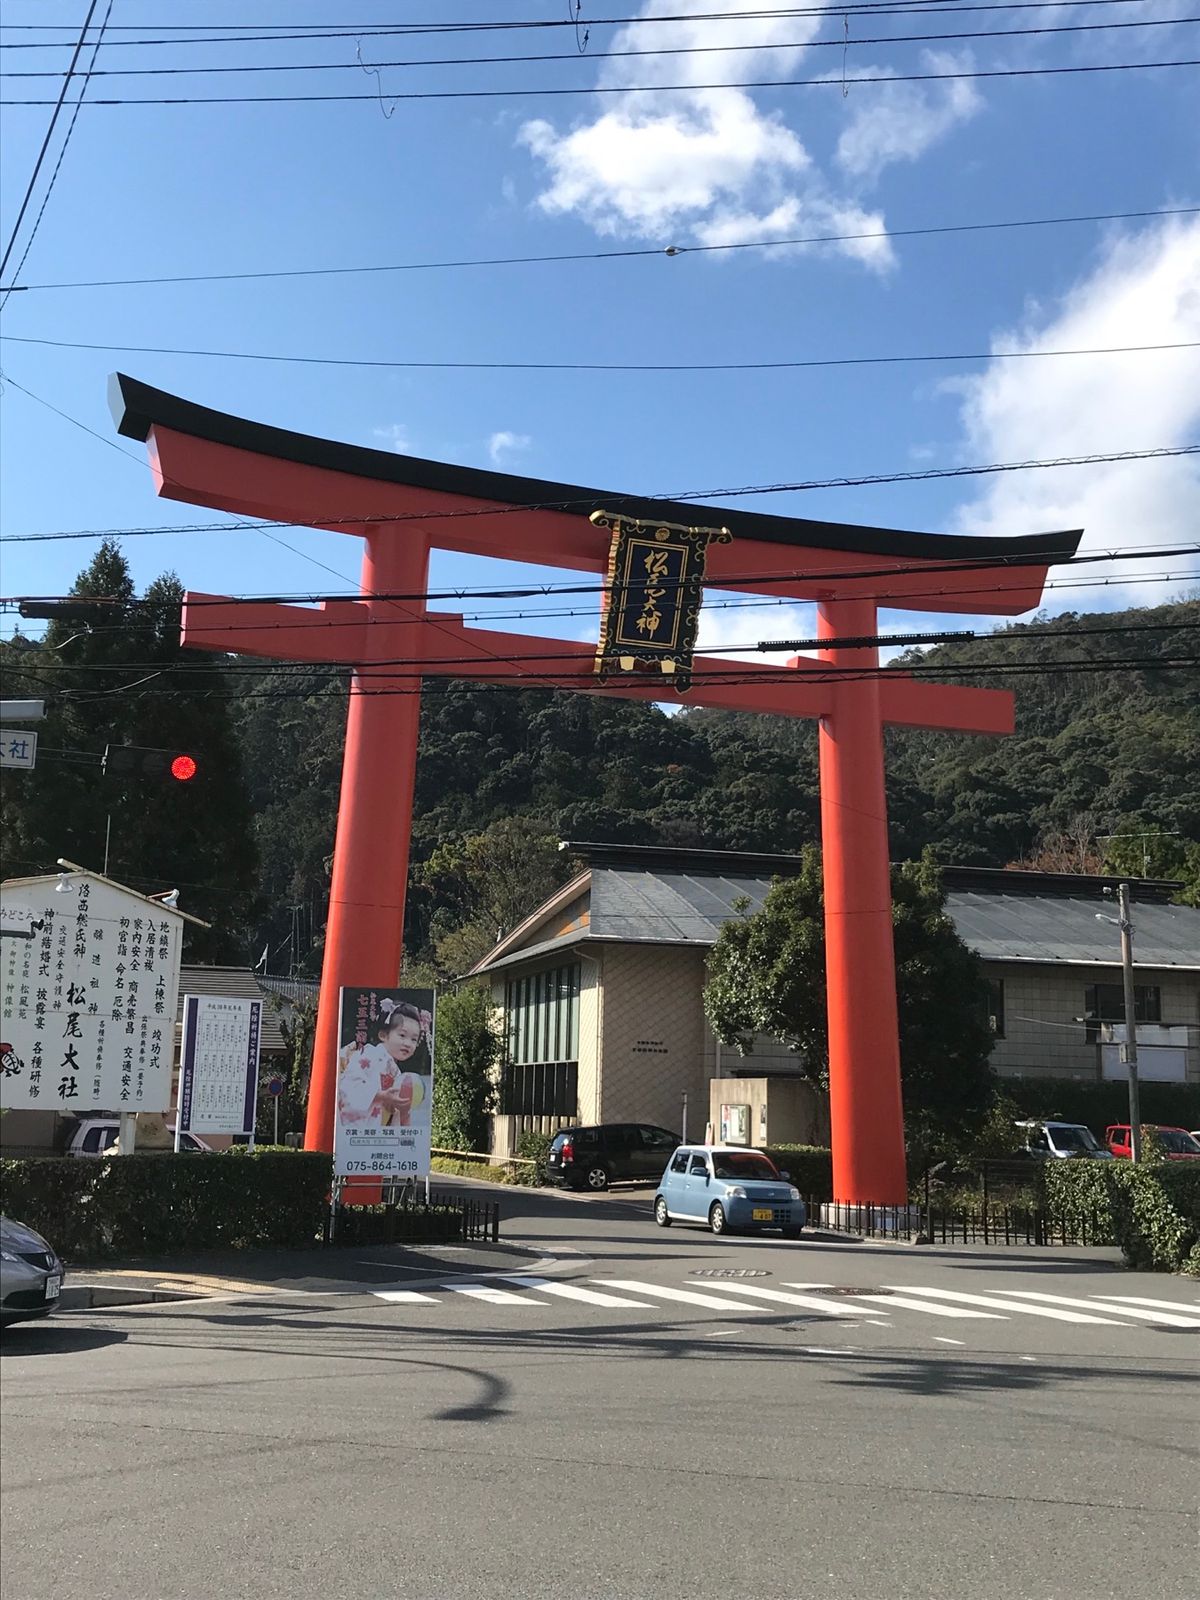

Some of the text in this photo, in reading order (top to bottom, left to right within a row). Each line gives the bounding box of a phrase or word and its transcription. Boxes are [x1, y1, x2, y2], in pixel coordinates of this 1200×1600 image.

[0, 739, 29, 760] 社
[111, 916, 130, 1021] 初宮詣 命名 厄除
[144, 919, 157, 973] 入居清祓
[149, 921, 170, 1069] 地鎮祭 上棟祭 竣功式
[29, 908, 55, 1098] 神前結婚式 披露宴 各種研修
[58, 982, 86, 1100] 松尾大社
[120, 918, 143, 1101] 家内安全 商売繁昌 交通安全
[346, 1161, 418, 1171] 075-864-1618
